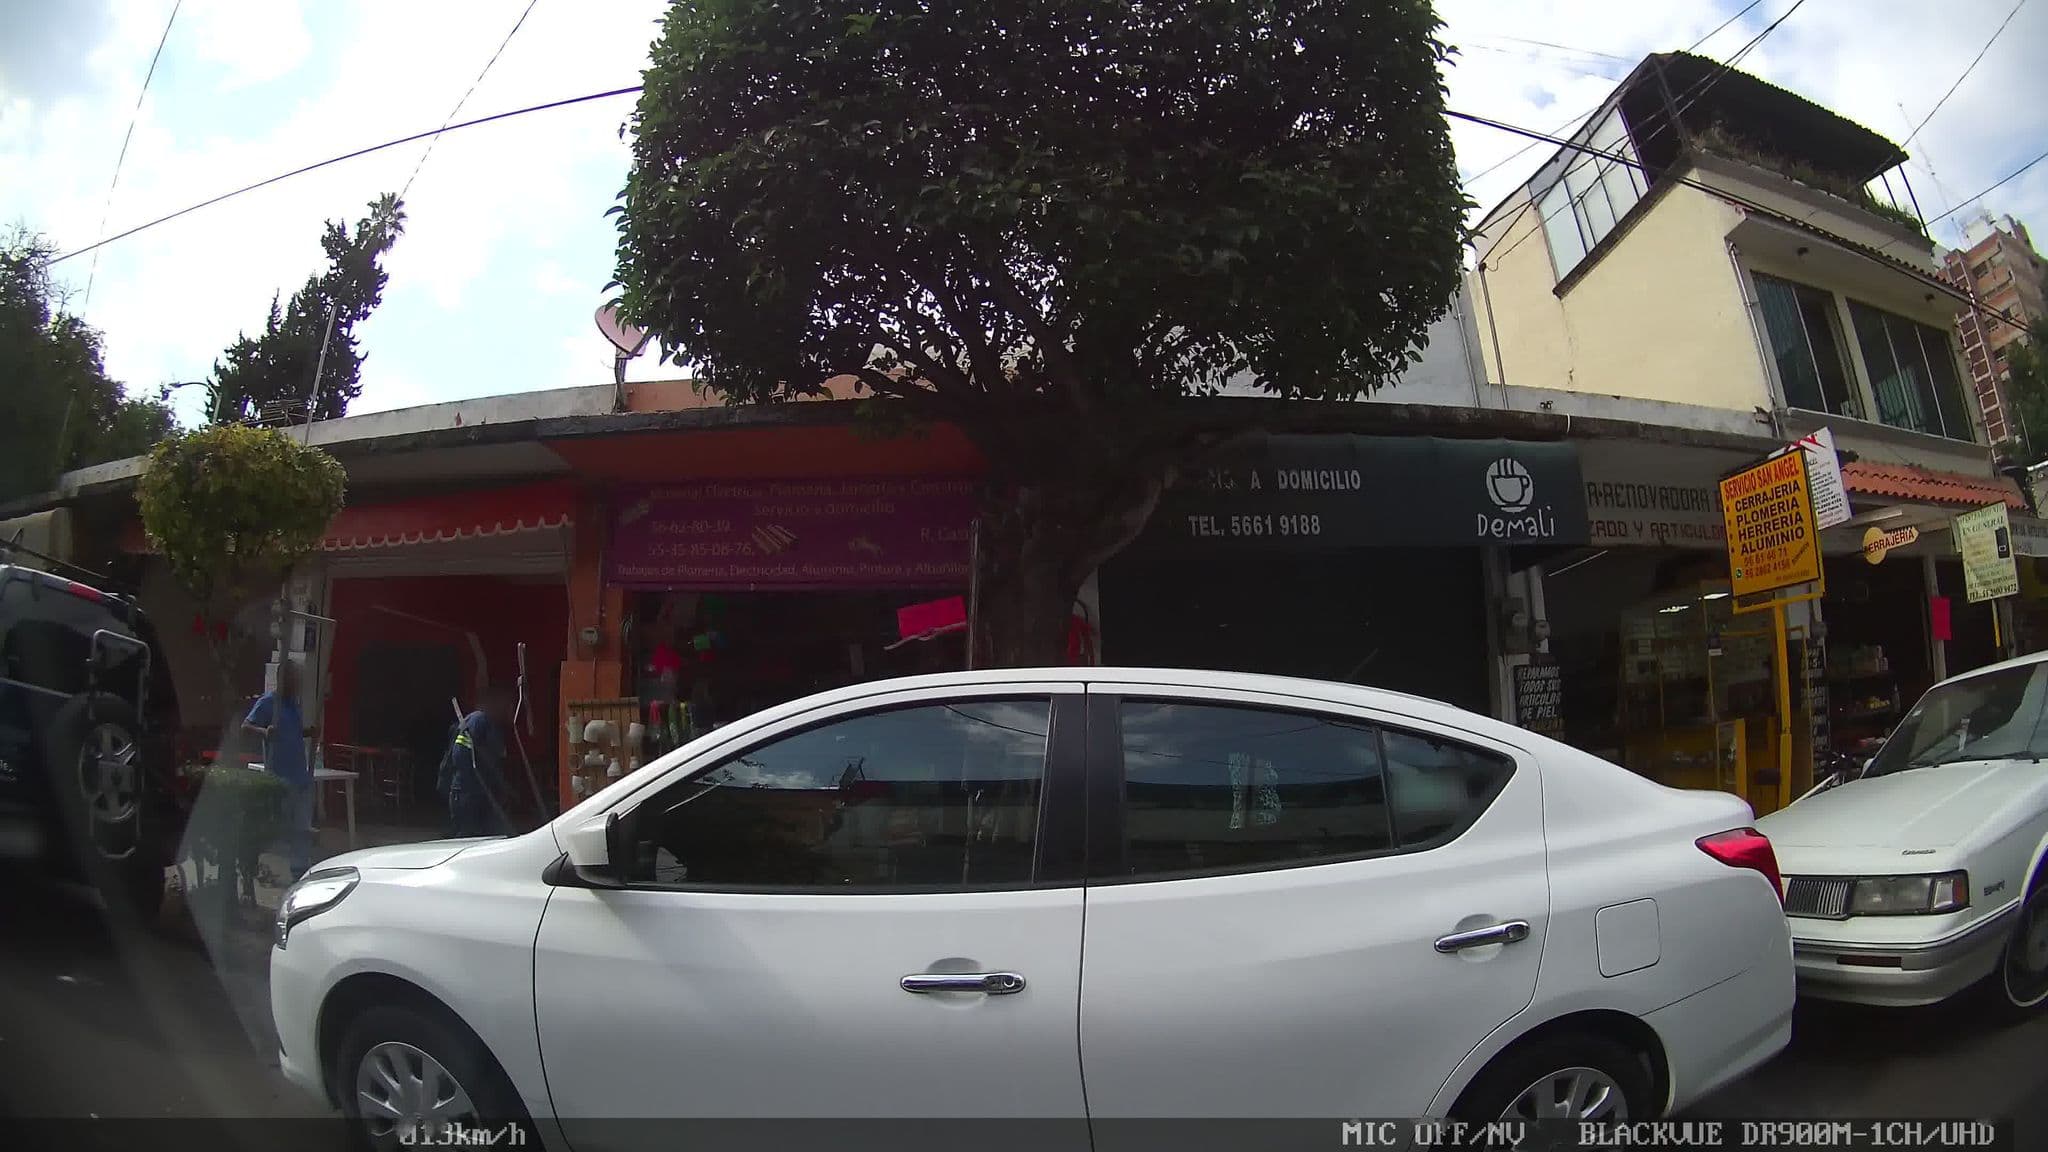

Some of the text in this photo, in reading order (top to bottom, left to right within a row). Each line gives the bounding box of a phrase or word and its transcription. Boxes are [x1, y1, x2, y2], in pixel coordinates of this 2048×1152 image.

[1249, 469, 1262, 489] A
[1277, 468, 1361, 490] DOMICILIO
[1724, 471, 1758, 501] SERVICIO
[1757, 466, 1774, 488] SAN
[1774, 455, 1800, 481] ANGEL
[1735, 480, 1801, 512] CERRAJERIA
[1230, 514, 1272, 536] 5661
[1279, 513, 1321, 536] 9188
[1736, 496, 1800, 527] PLOMERIA
[1633, 521, 1643, 539] Y
[1738, 511, 1804, 543] HERRERIA
[1741, 526, 1805, 556] ALUMINIO
[1536, 705, 1558, 719] PIEL
